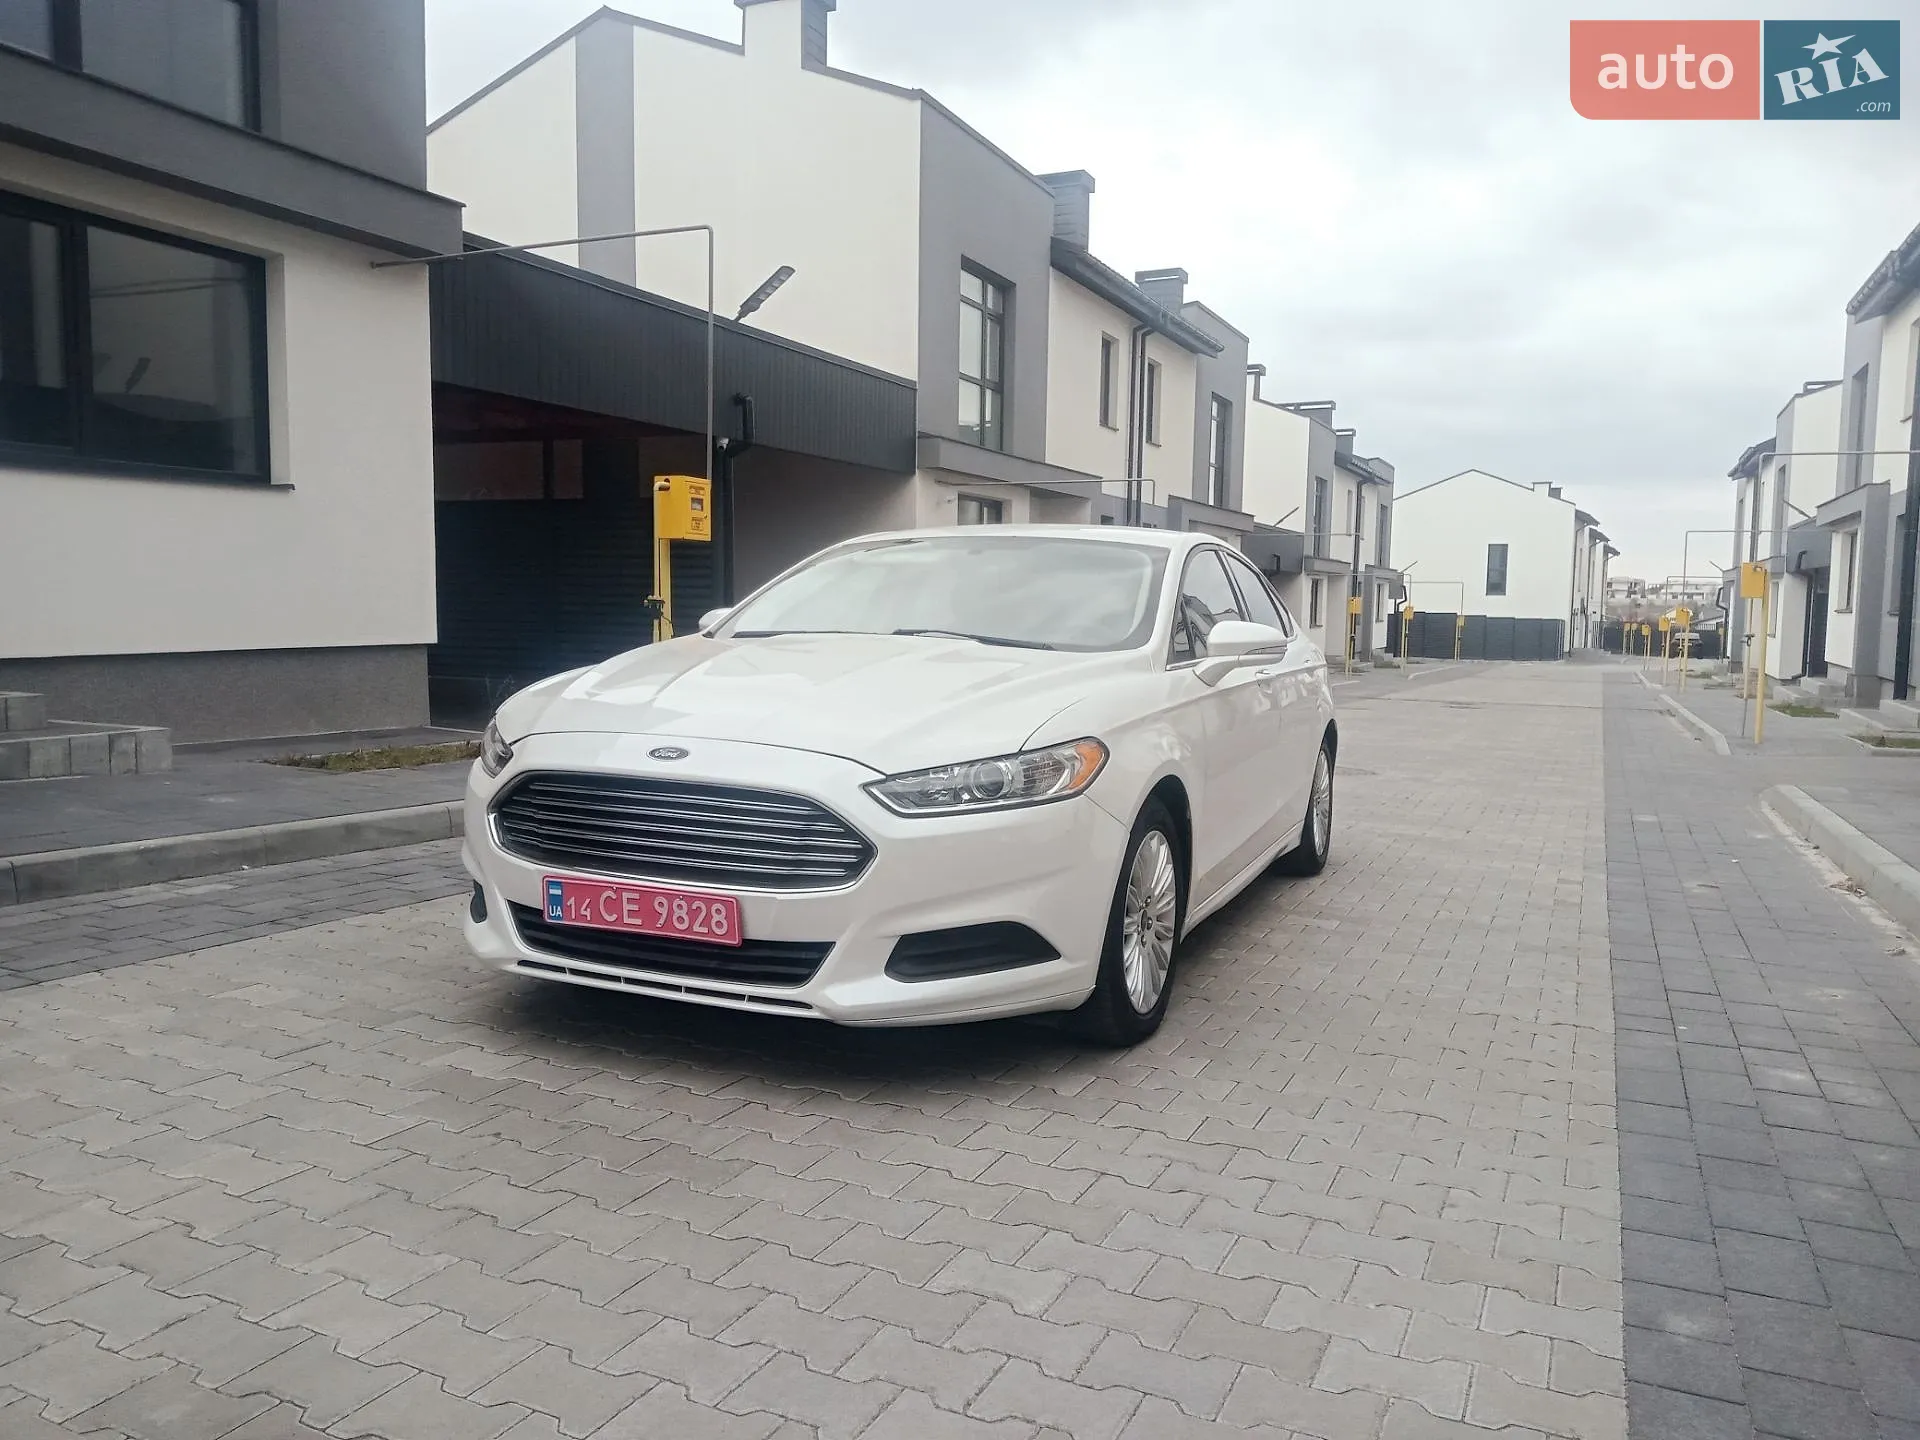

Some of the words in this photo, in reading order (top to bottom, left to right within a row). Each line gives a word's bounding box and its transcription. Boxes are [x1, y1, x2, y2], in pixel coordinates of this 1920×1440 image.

[549, 904, 563, 918] UA
[566, 896, 591, 921] 14
[599, 890, 643, 926] CE
[653, 896, 729, 936] 9828
